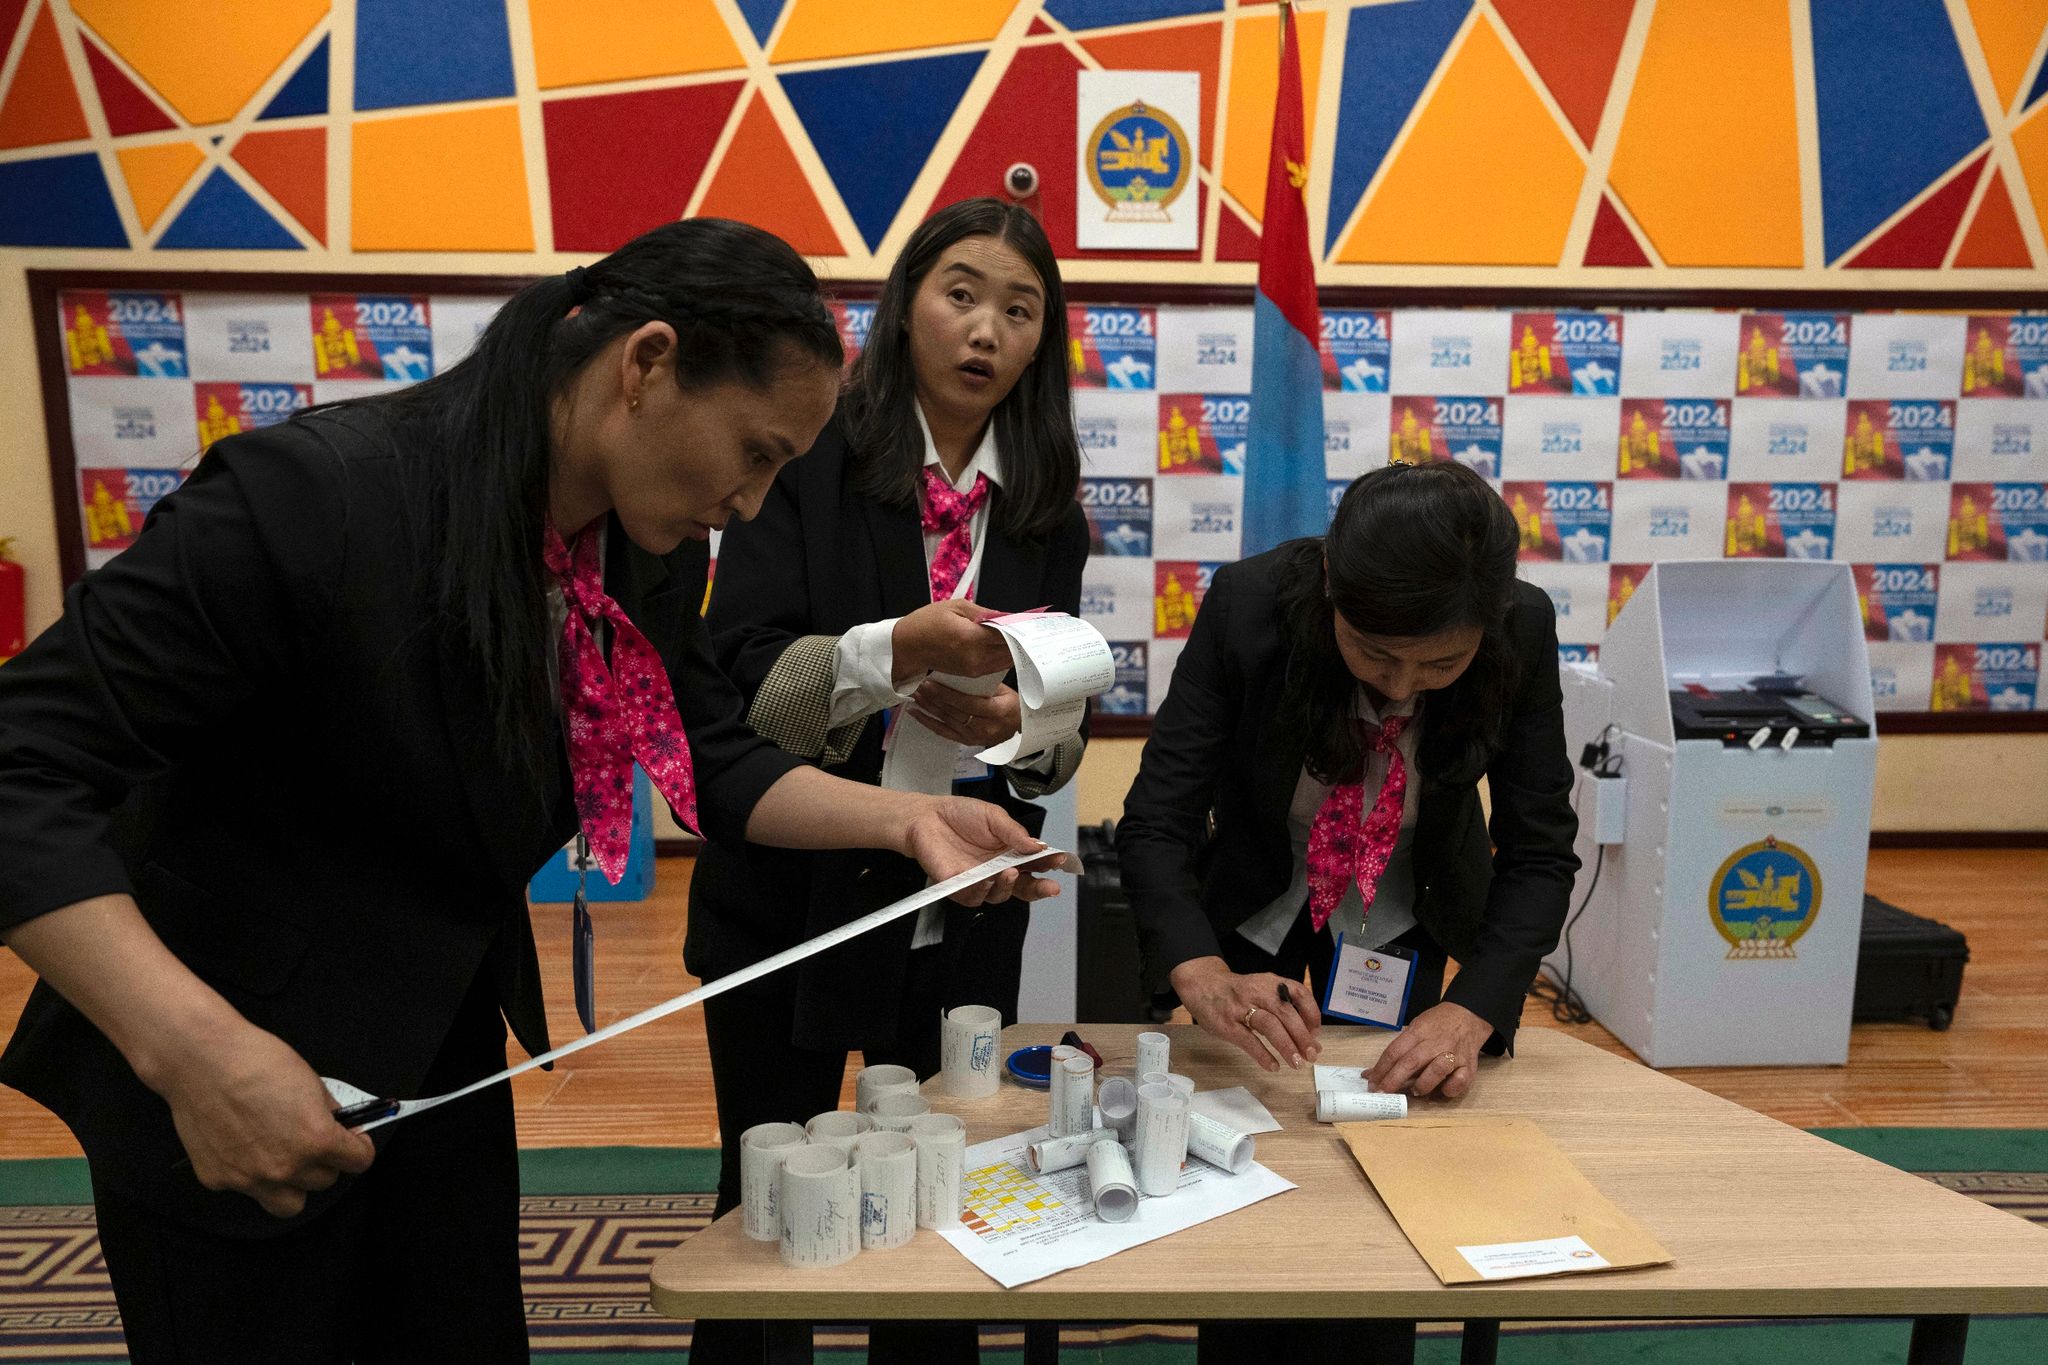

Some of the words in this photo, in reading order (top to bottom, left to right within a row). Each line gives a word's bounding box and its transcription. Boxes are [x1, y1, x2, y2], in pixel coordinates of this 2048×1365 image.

[108, 301, 179, 324] 2024
[355, 304, 425, 326] 2024
[845, 309, 876, 332] 20
[1083, 313, 1152, 335] 2024
[1320, 317, 1386, 339] 2024
[1553, 321, 1618, 343] 2024
[1782, 322, 1846, 344] 2024
[240, 390, 308, 411] 2024
[1201, 402, 1250, 423] 202
[1434, 403, 1498, 425] 2024
[1662, 405, 1726, 427] 2024
[1887, 406, 1952, 428] 2024
[125, 475, 178, 497] 202
[1083, 484, 1148, 506] 2024
[1544, 487, 1608, 510] 2024
[1769, 489, 1832, 511] 2024
[1873, 570, 1935, 592] 2024
[1115, 645, 1145, 668] 24
[1975, 649, 2037, 671] 2024
